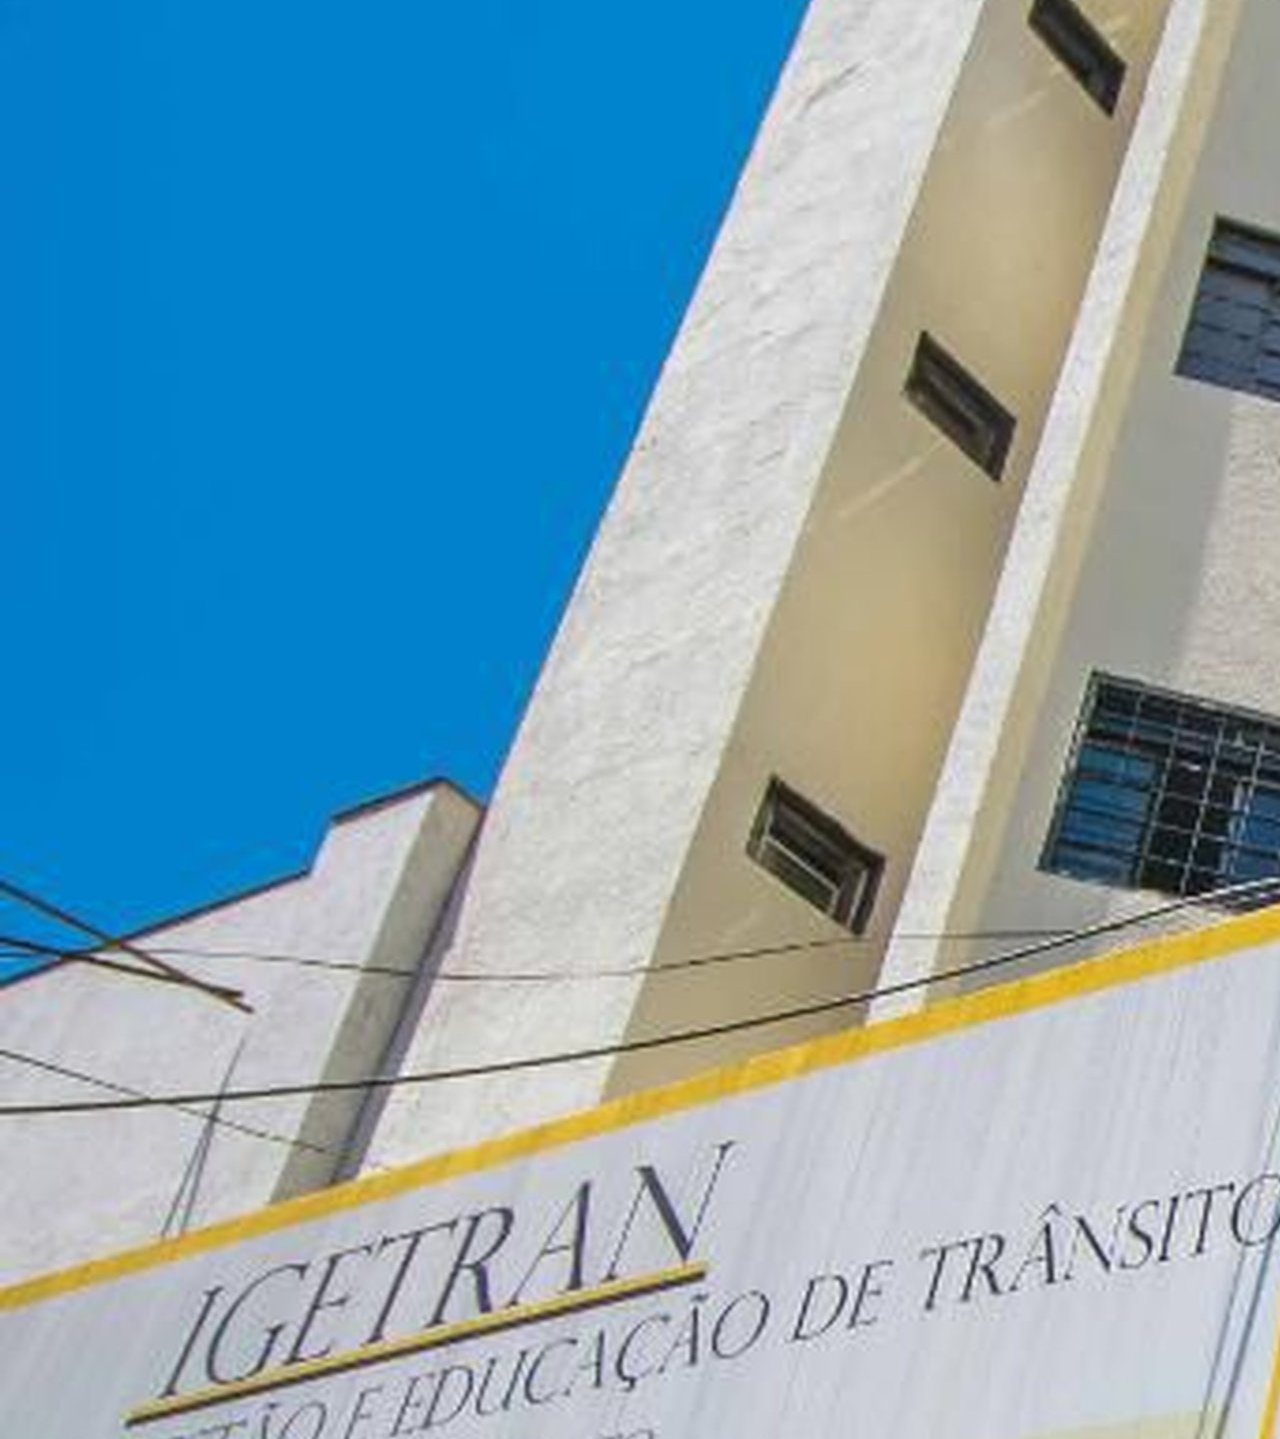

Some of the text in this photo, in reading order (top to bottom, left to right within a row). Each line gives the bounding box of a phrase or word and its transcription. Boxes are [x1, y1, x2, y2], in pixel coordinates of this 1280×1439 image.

[164, 1139, 738, 1397] IGETRAN
[389, 1289, 771, 1438] EDUCAÇÃO
[786, 1259, 894, 1344] DE
